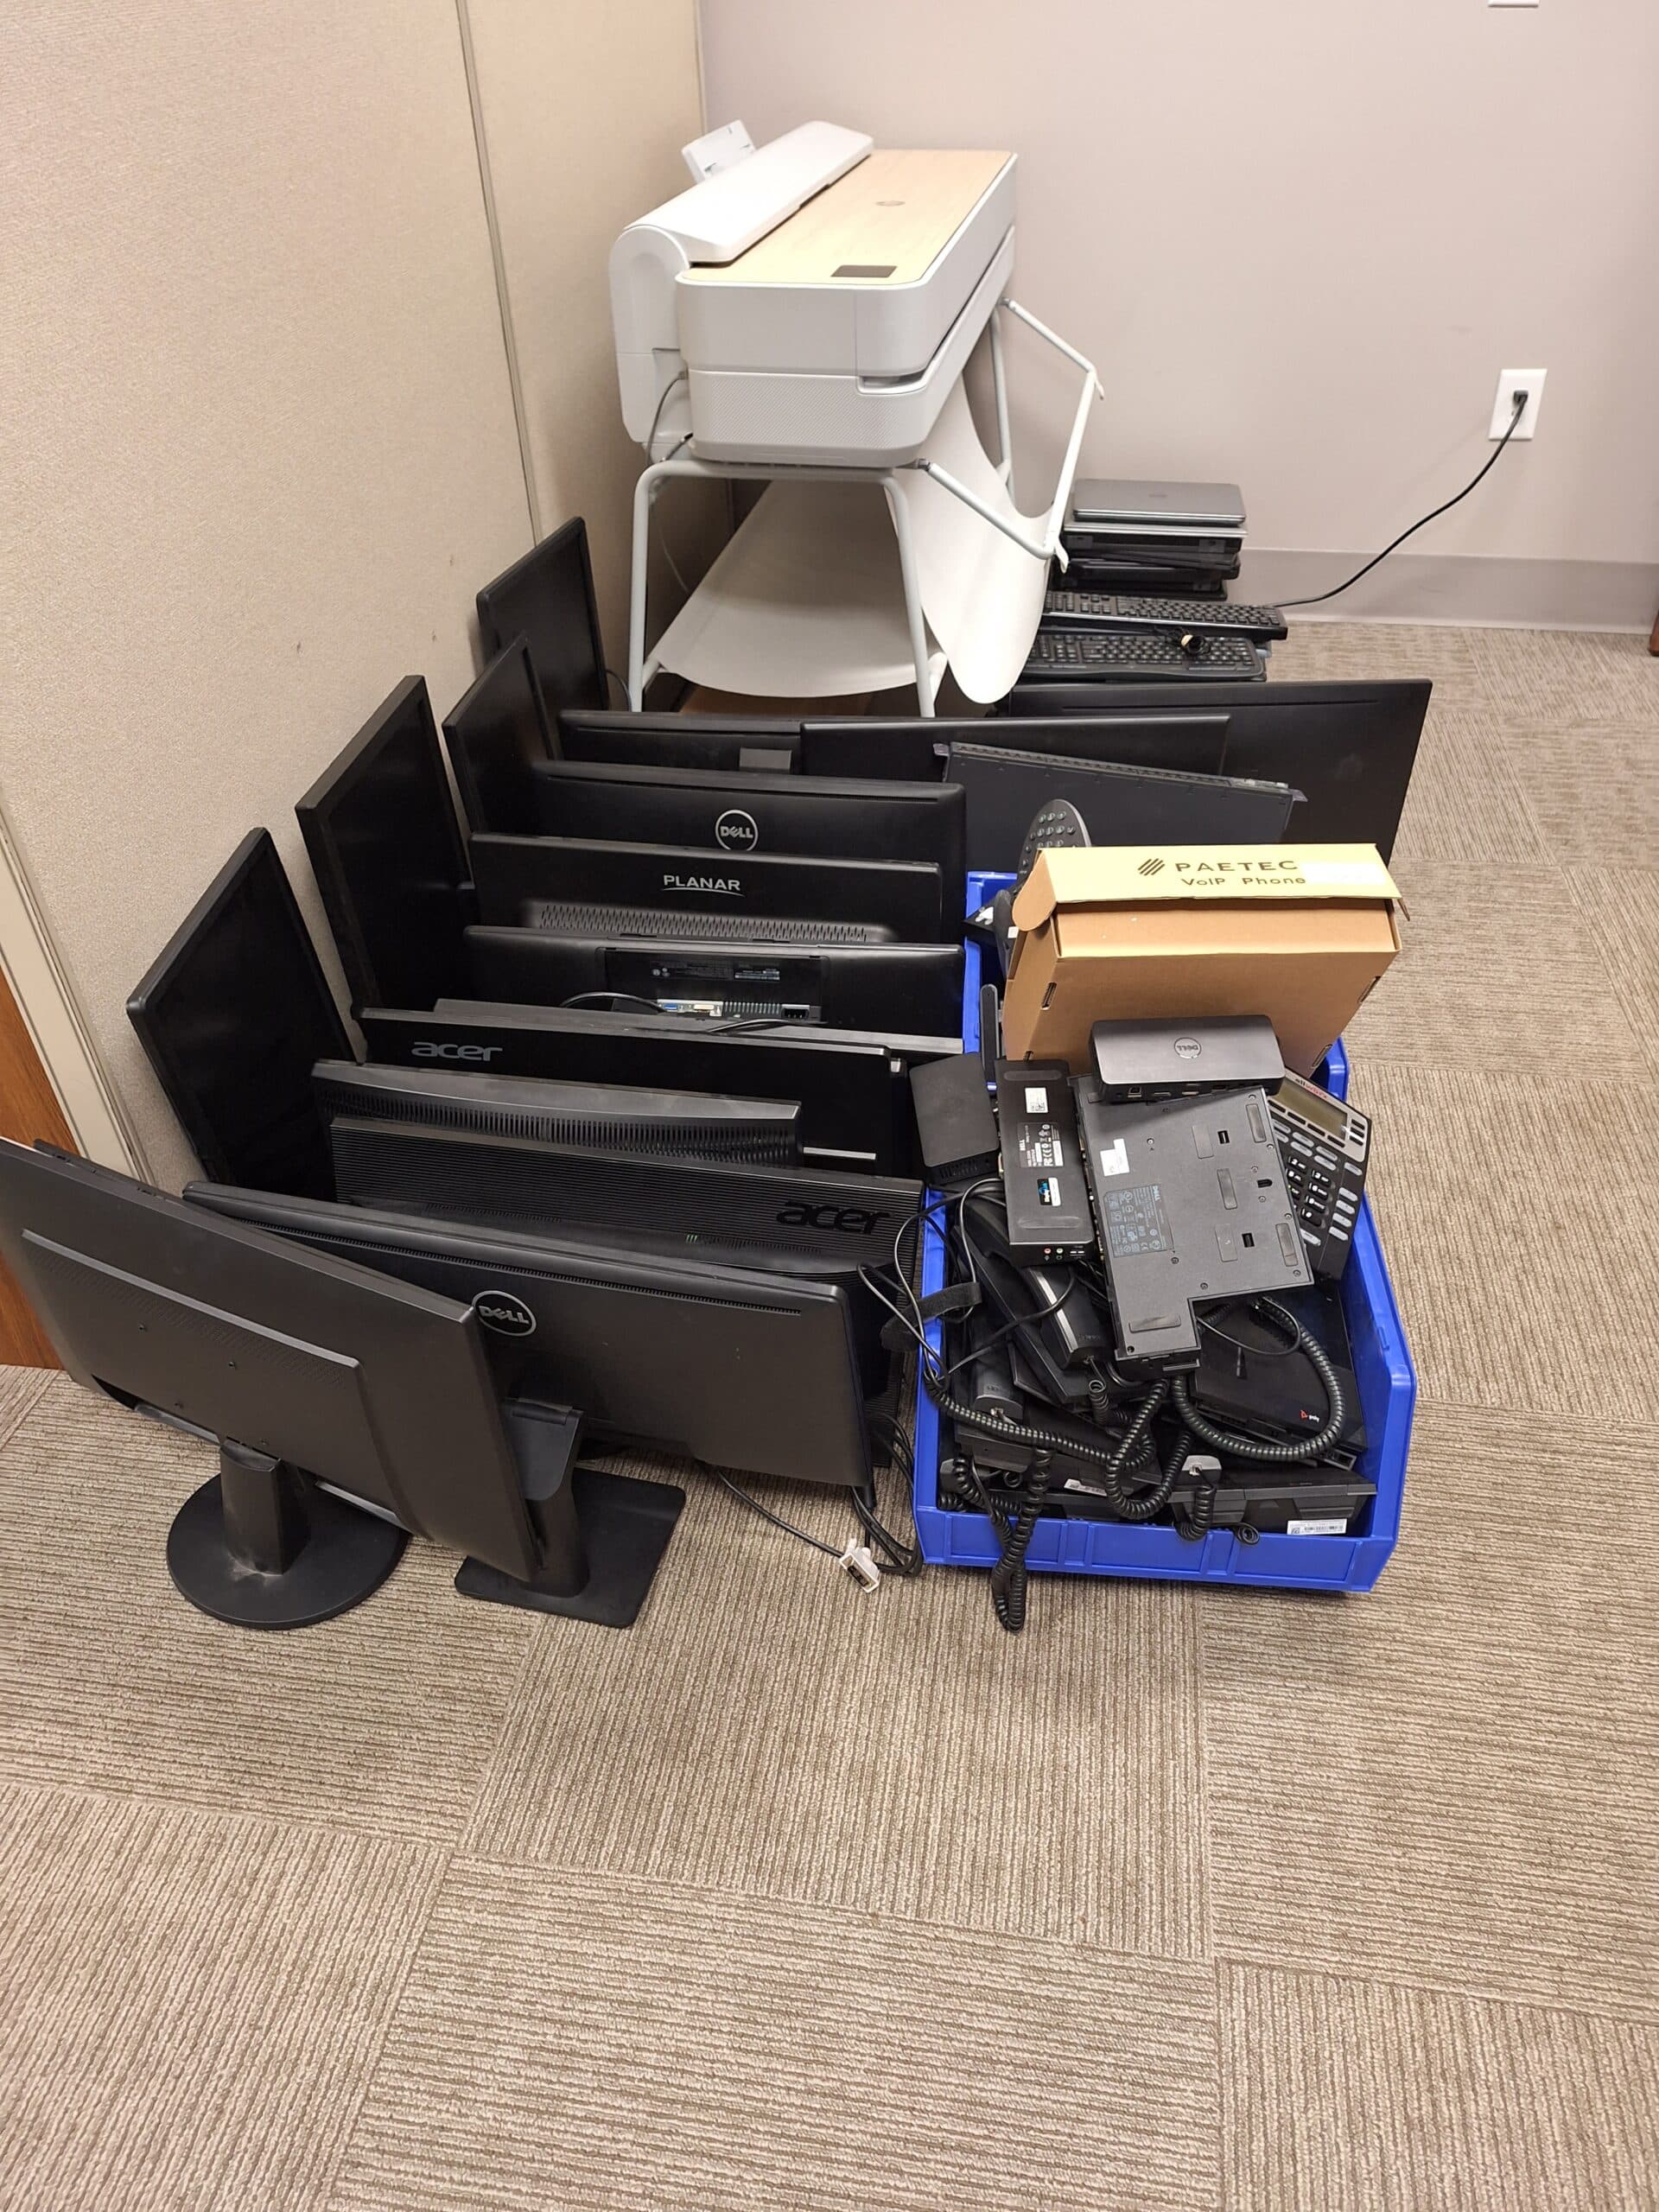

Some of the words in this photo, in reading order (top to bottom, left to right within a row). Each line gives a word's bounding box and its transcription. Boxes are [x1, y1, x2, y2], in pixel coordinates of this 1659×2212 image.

[720, 826, 753, 838] DELL
[1174, 860, 1299, 872] PAETEC
[663, 874, 741, 891] PLANAR
[1180, 877, 1226, 886] VoIP
[1242, 876, 1306, 886] Phone
[411, 1041, 503, 1061] acer
[777, 1200, 891, 1235] acer
[478, 1306, 530, 1324] DELL
